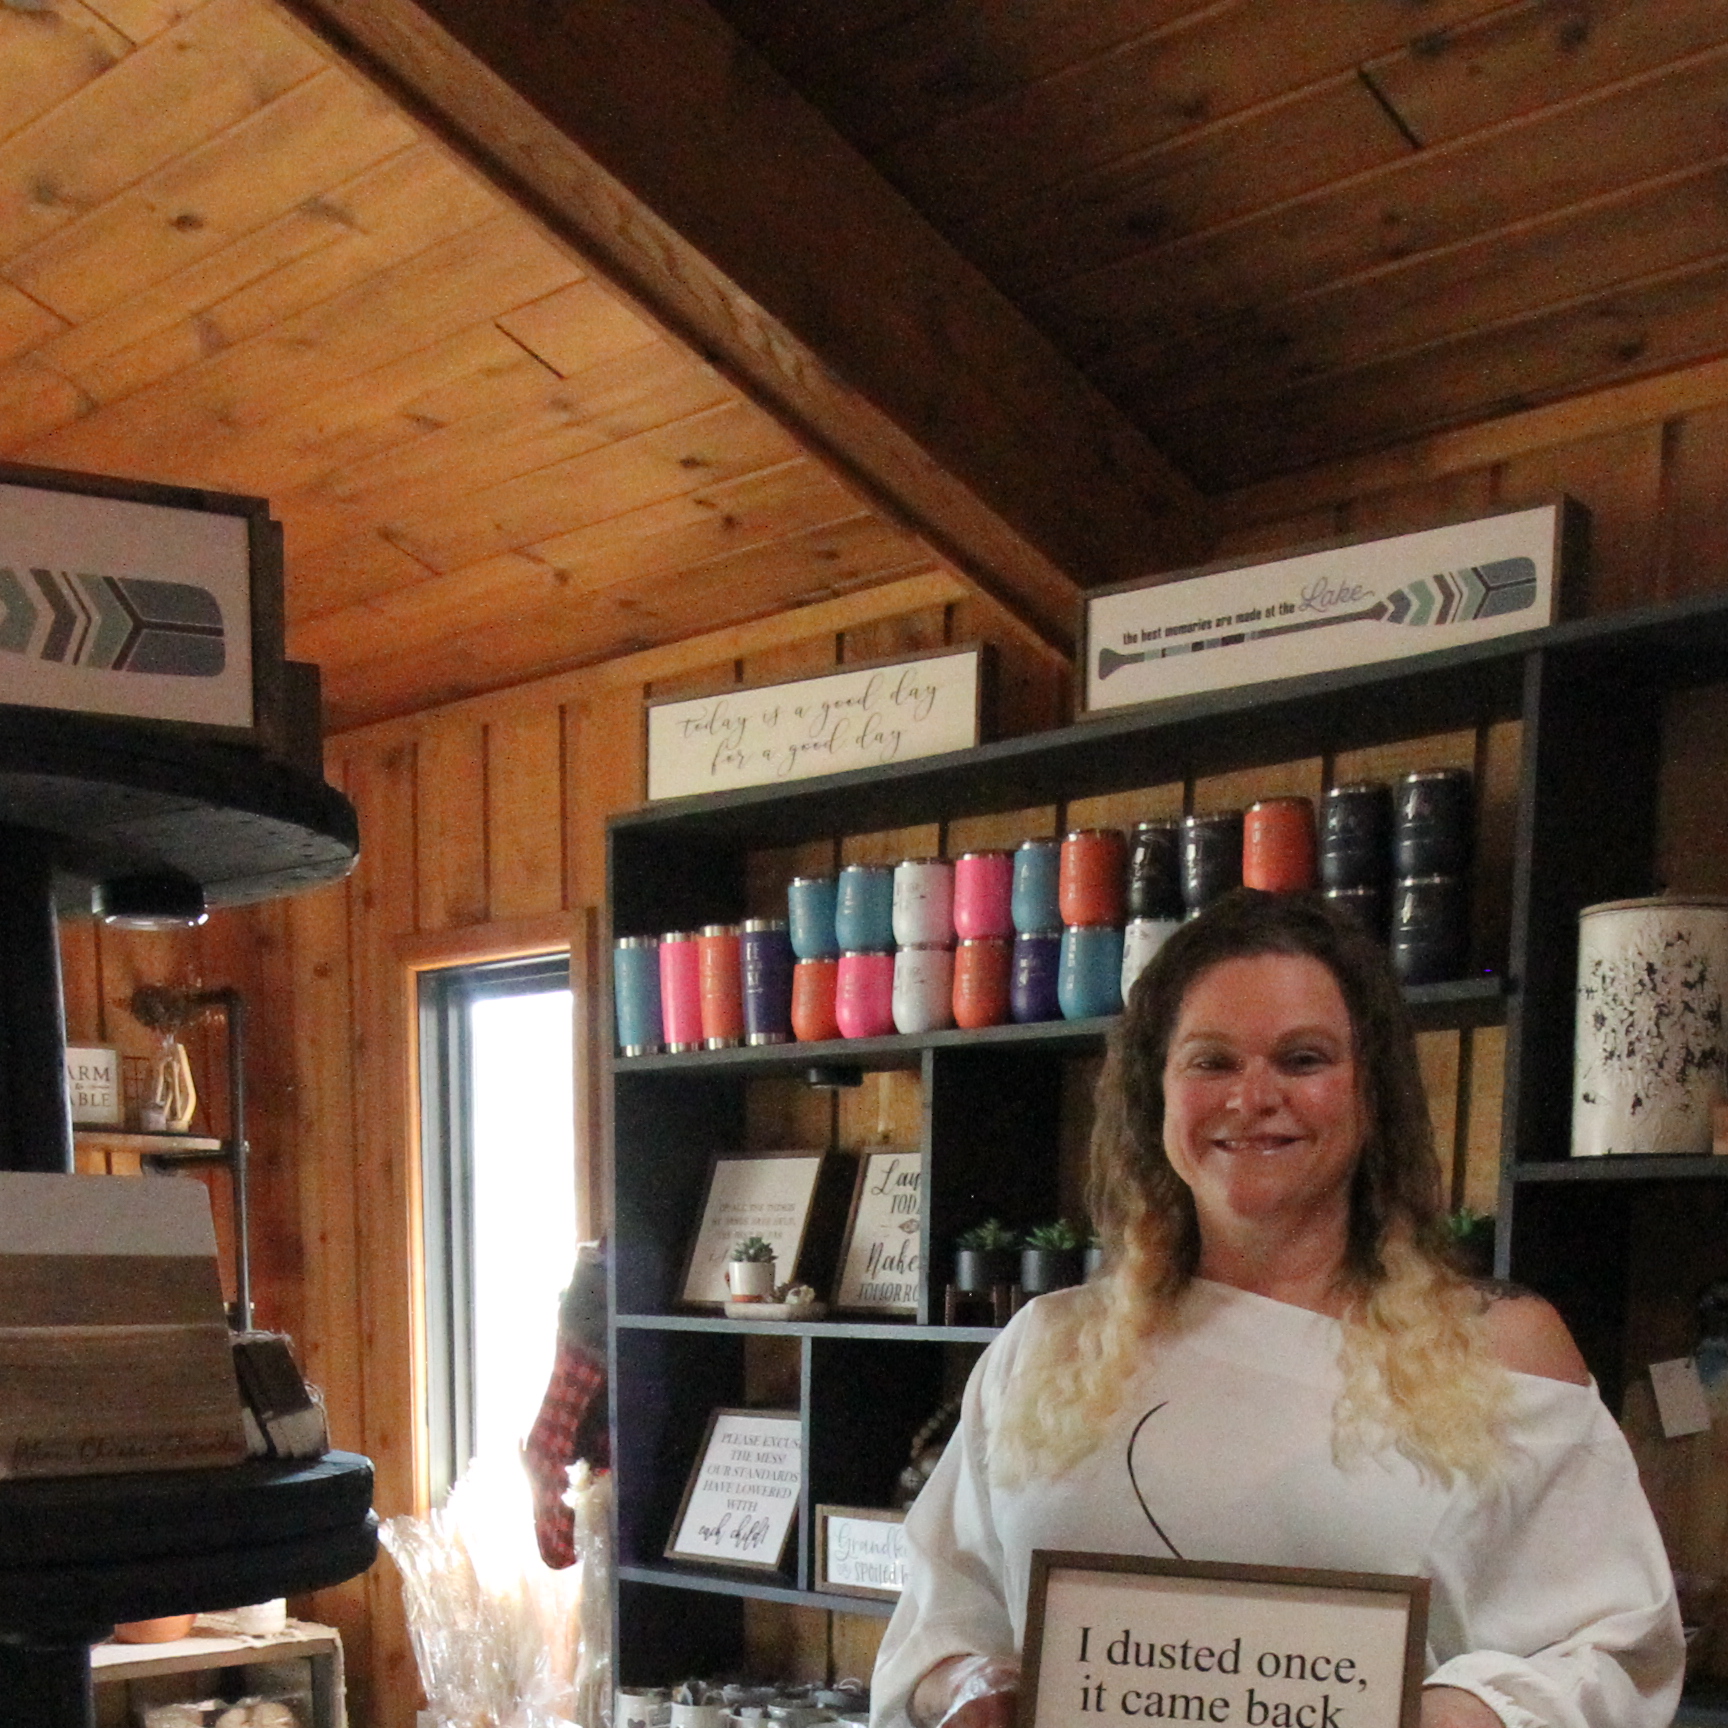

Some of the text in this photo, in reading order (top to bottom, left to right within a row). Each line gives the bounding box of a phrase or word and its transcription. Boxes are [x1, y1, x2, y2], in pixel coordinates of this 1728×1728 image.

[1123, 576, 1375, 645] the best memories are made at the Lake
[812, 675, 879, 723] good
[890, 669, 941, 721] day
[777, 718, 847, 779] good
[855, 713, 908, 761] day
[721, 1432, 801, 1449] PLEASE EXCUS
[731, 1450, 752, 1462] THE
[703, 1480, 792, 1499] HAVE LOWERED
[707, 1464, 800, 1482] OUR STANDARDS
[727, 1498, 759, 1512] WITH
[1077, 1627, 1368, 1692] I dusted once,
[1080, 1674, 1107, 1712] it
[1121, 1689, 1231, 1724] came
